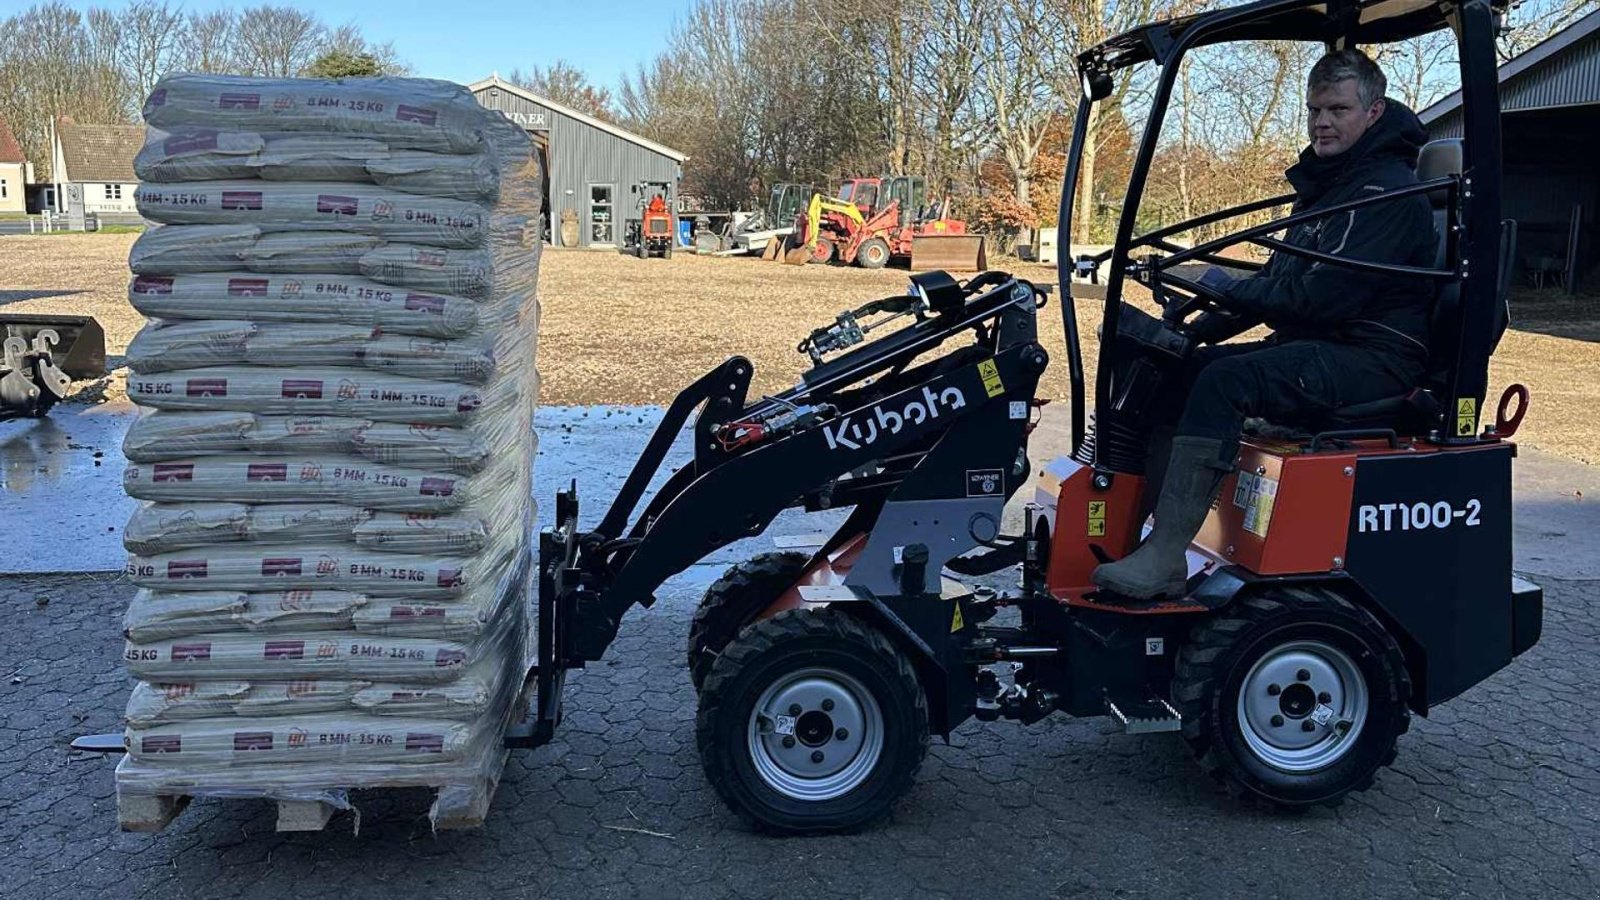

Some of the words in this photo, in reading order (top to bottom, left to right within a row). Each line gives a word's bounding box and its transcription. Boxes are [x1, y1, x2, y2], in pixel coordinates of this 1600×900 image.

[171, 193, 188, 205] 15
[190, 194, 207, 205] KG
[315, 283, 324, 293] 8
[327, 284, 349, 295] MM
[358, 287, 373, 299] 15
[375, 291, 393, 302] KG
[137, 382, 153, 394] 15
[155, 383, 173, 395] KG
[381, 390, 403, 402] MM
[411, 394, 427, 406] 15
[428, 395, 447, 408] KG
[823, 386, 966, 450] Kubota
[344, 468, 366, 480] MM
[374, 473, 390, 485] 15
[391, 476, 408, 487] KG
[1358, 499, 1481, 533] RT100-2
[138, 565, 154, 577] KG
[350, 563, 358, 574] 8
[361, 564, 382, 577] MM
[390, 568, 406, 579] 15
[408, 569, 425, 582] KG
[141, 650, 158, 661] KG
[350, 644, 358, 655] 8
[361, 645, 382, 657] MM
[390, 648, 406, 658] 15
[408, 649, 425, 661] KG
[319, 734, 327, 744] 8
[329, 734, 351, 745] MM
[359, 734, 374, 745] 15
[376, 734, 393, 746] KG
